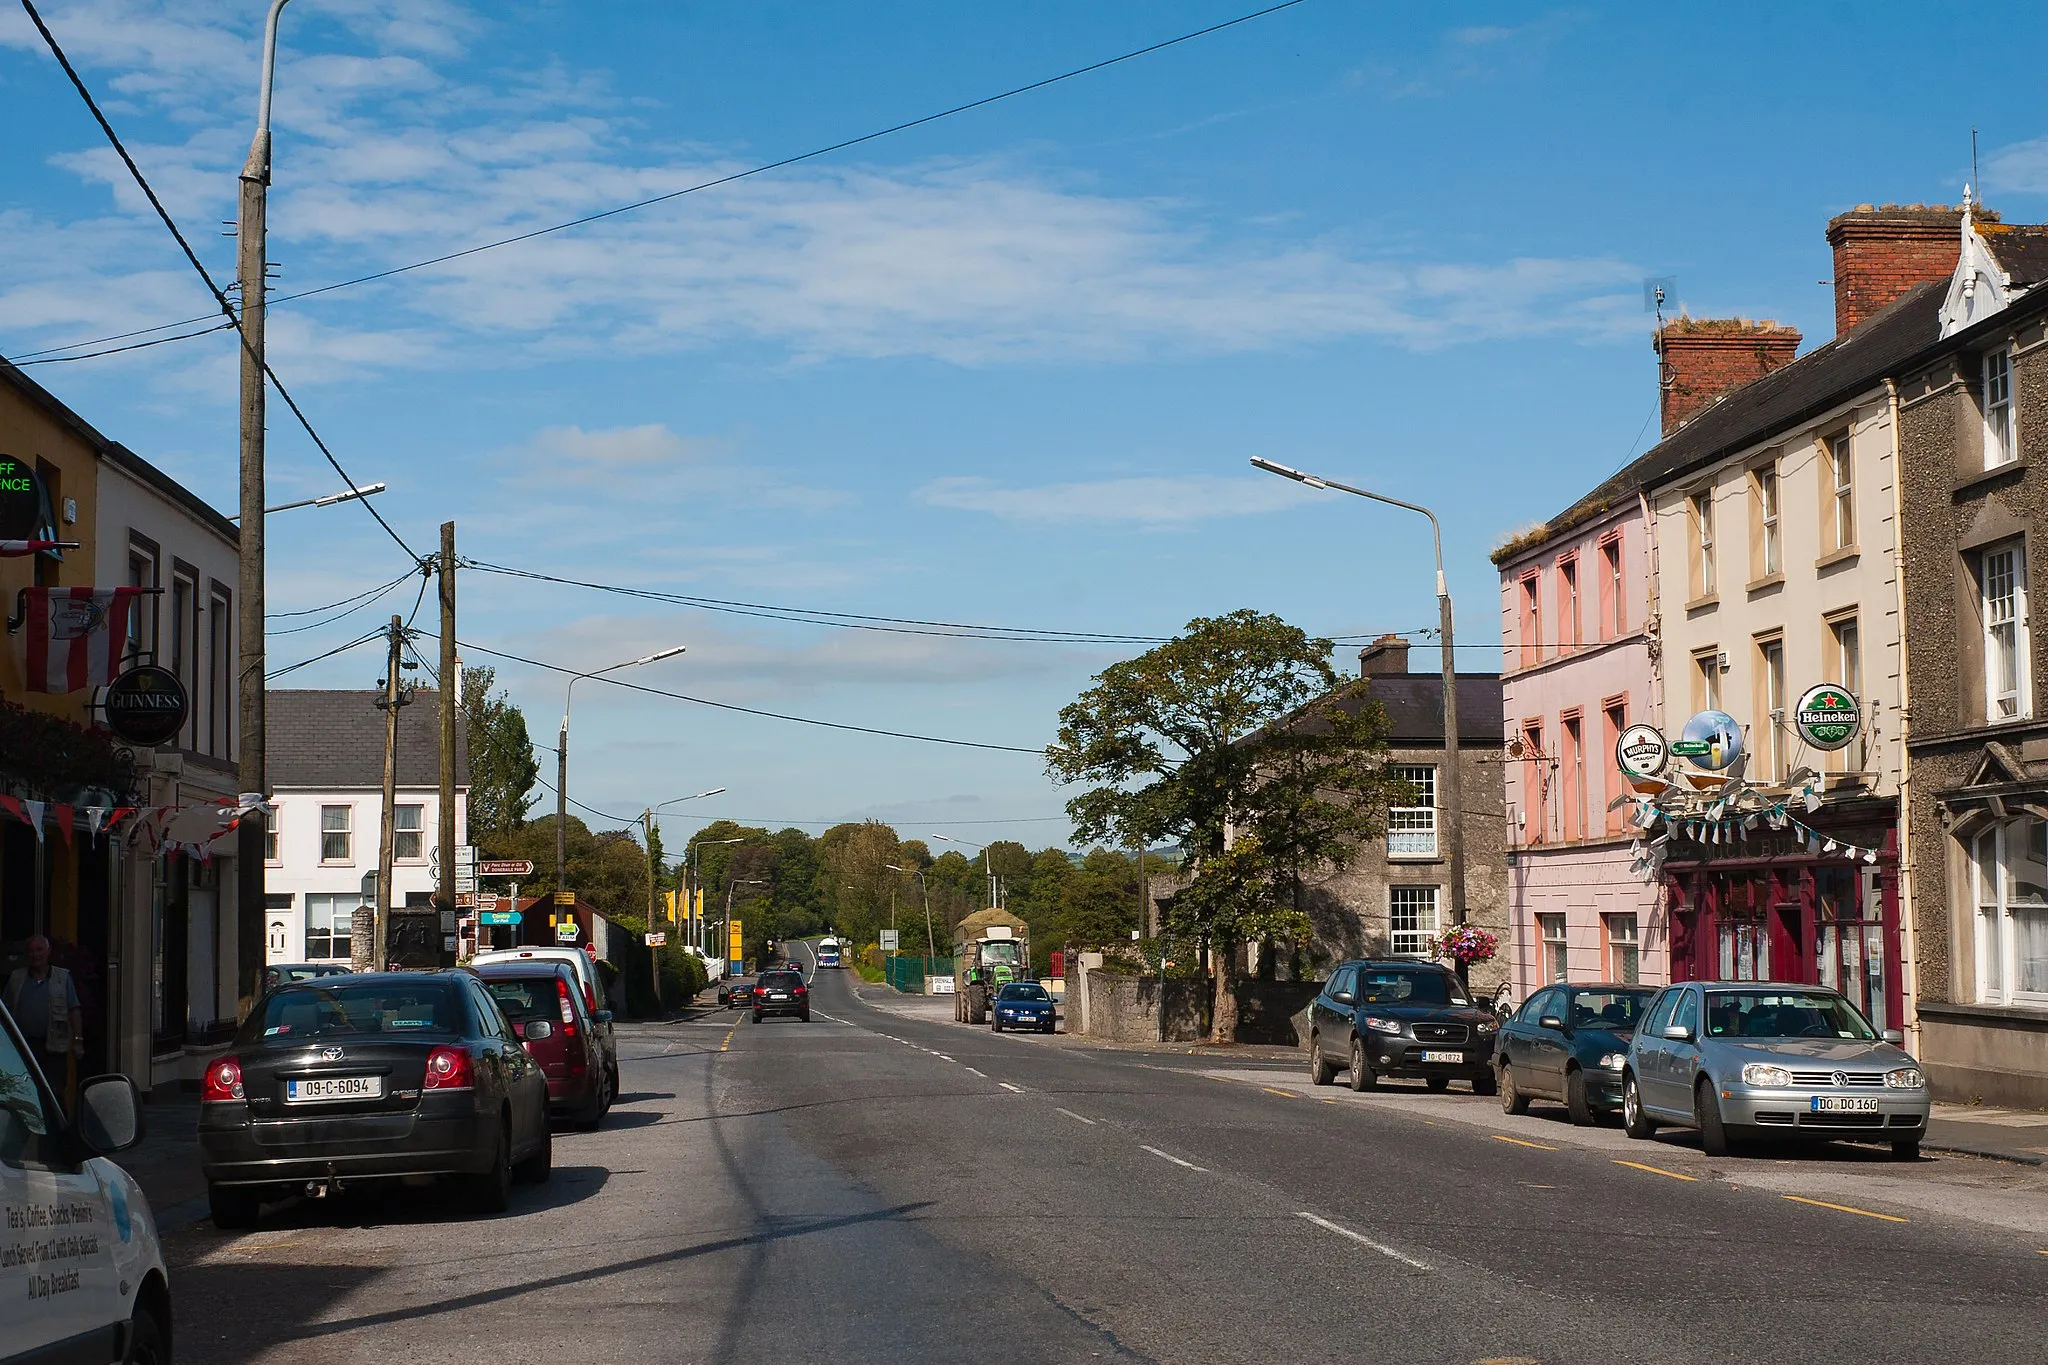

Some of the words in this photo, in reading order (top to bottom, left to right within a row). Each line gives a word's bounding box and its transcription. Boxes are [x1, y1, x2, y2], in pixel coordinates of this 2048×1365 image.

[0, 478, 30, 490] NCE
[111, 692, 180, 708] GUINNESS
[1802, 712, 1856, 722] Heineken
[306, 1079, 368, 1095] 09-C-6094
[1819, 1098, 1833, 1109] DO
[1841, 1098, 1854, 1110] DO
[6, 1206, 25, 1231] Tea's,
[27, 1204, 48, 1230] Coffee,
[49, 1203, 71, 1228] Snacks,
[17, 1241, 36, 1265] Served
[36, 1240, 49, 1263] From
[80, 1233, 99, 1260] Specials
[28, 1275, 37, 1301] All
[38, 1275, 49, 1301] Day
[51, 1268, 80, 1295] Breakfast
